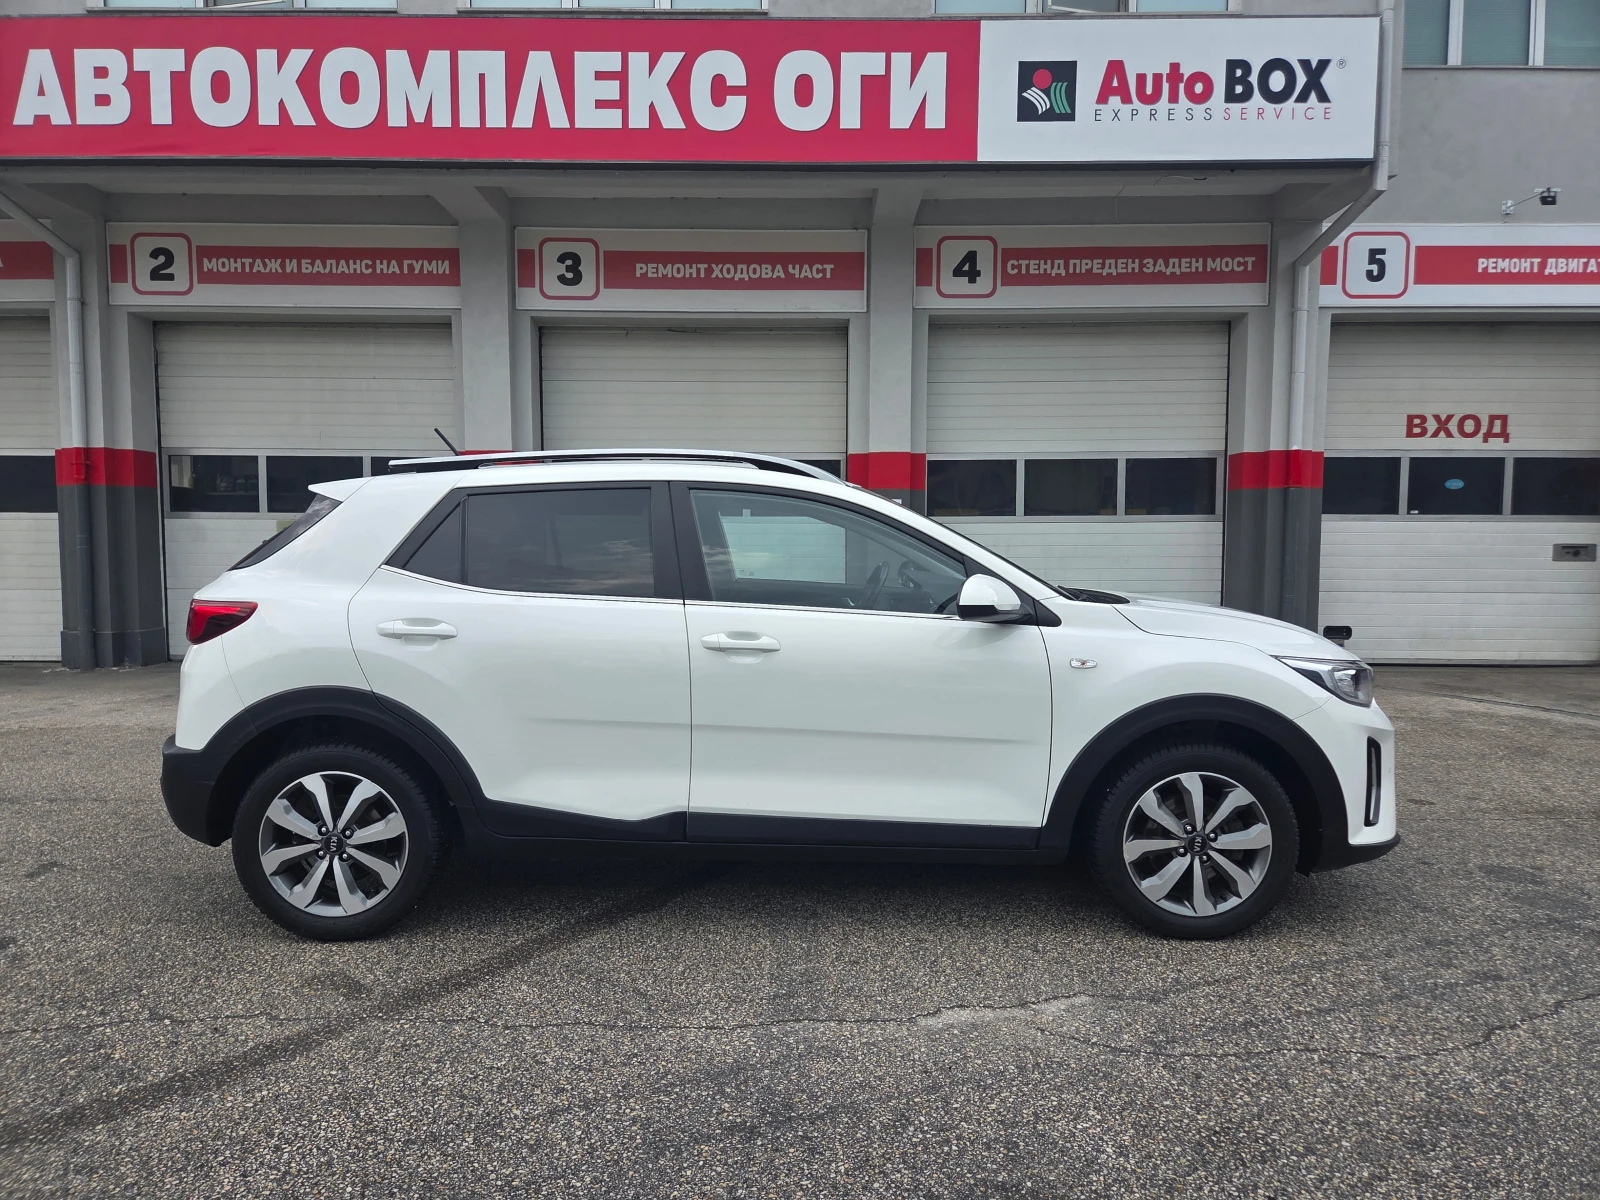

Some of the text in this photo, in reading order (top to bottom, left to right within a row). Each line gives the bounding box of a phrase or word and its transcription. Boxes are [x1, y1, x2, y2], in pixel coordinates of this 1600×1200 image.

[12, 46, 948, 132] АВТОКОМПЛЕКС ОГИ
[1095, 57, 1332, 106] Auto BOX
[1094, 106, 1332, 122] EXPRESS SERVICE
[148, 246, 176, 282] 2
[202, 257, 451, 275] МОНТАЖ И БАЛАНС НА ГУМИ
[556, 251, 584, 287] 3
[635, 263, 834, 281] РЕМОНТ ХОДОВА ЧАСТ
[951, 250, 982, 285] 4
[1006, 256, 1256, 277] СТЕНД ПРЕДЕН ЗАДЕН МОСТ
[1365, 248, 1387, 283] 5
[1477, 257, 1542, 273] РЕМОНТ
[1405, 413, 1510, 443] ВХОД
